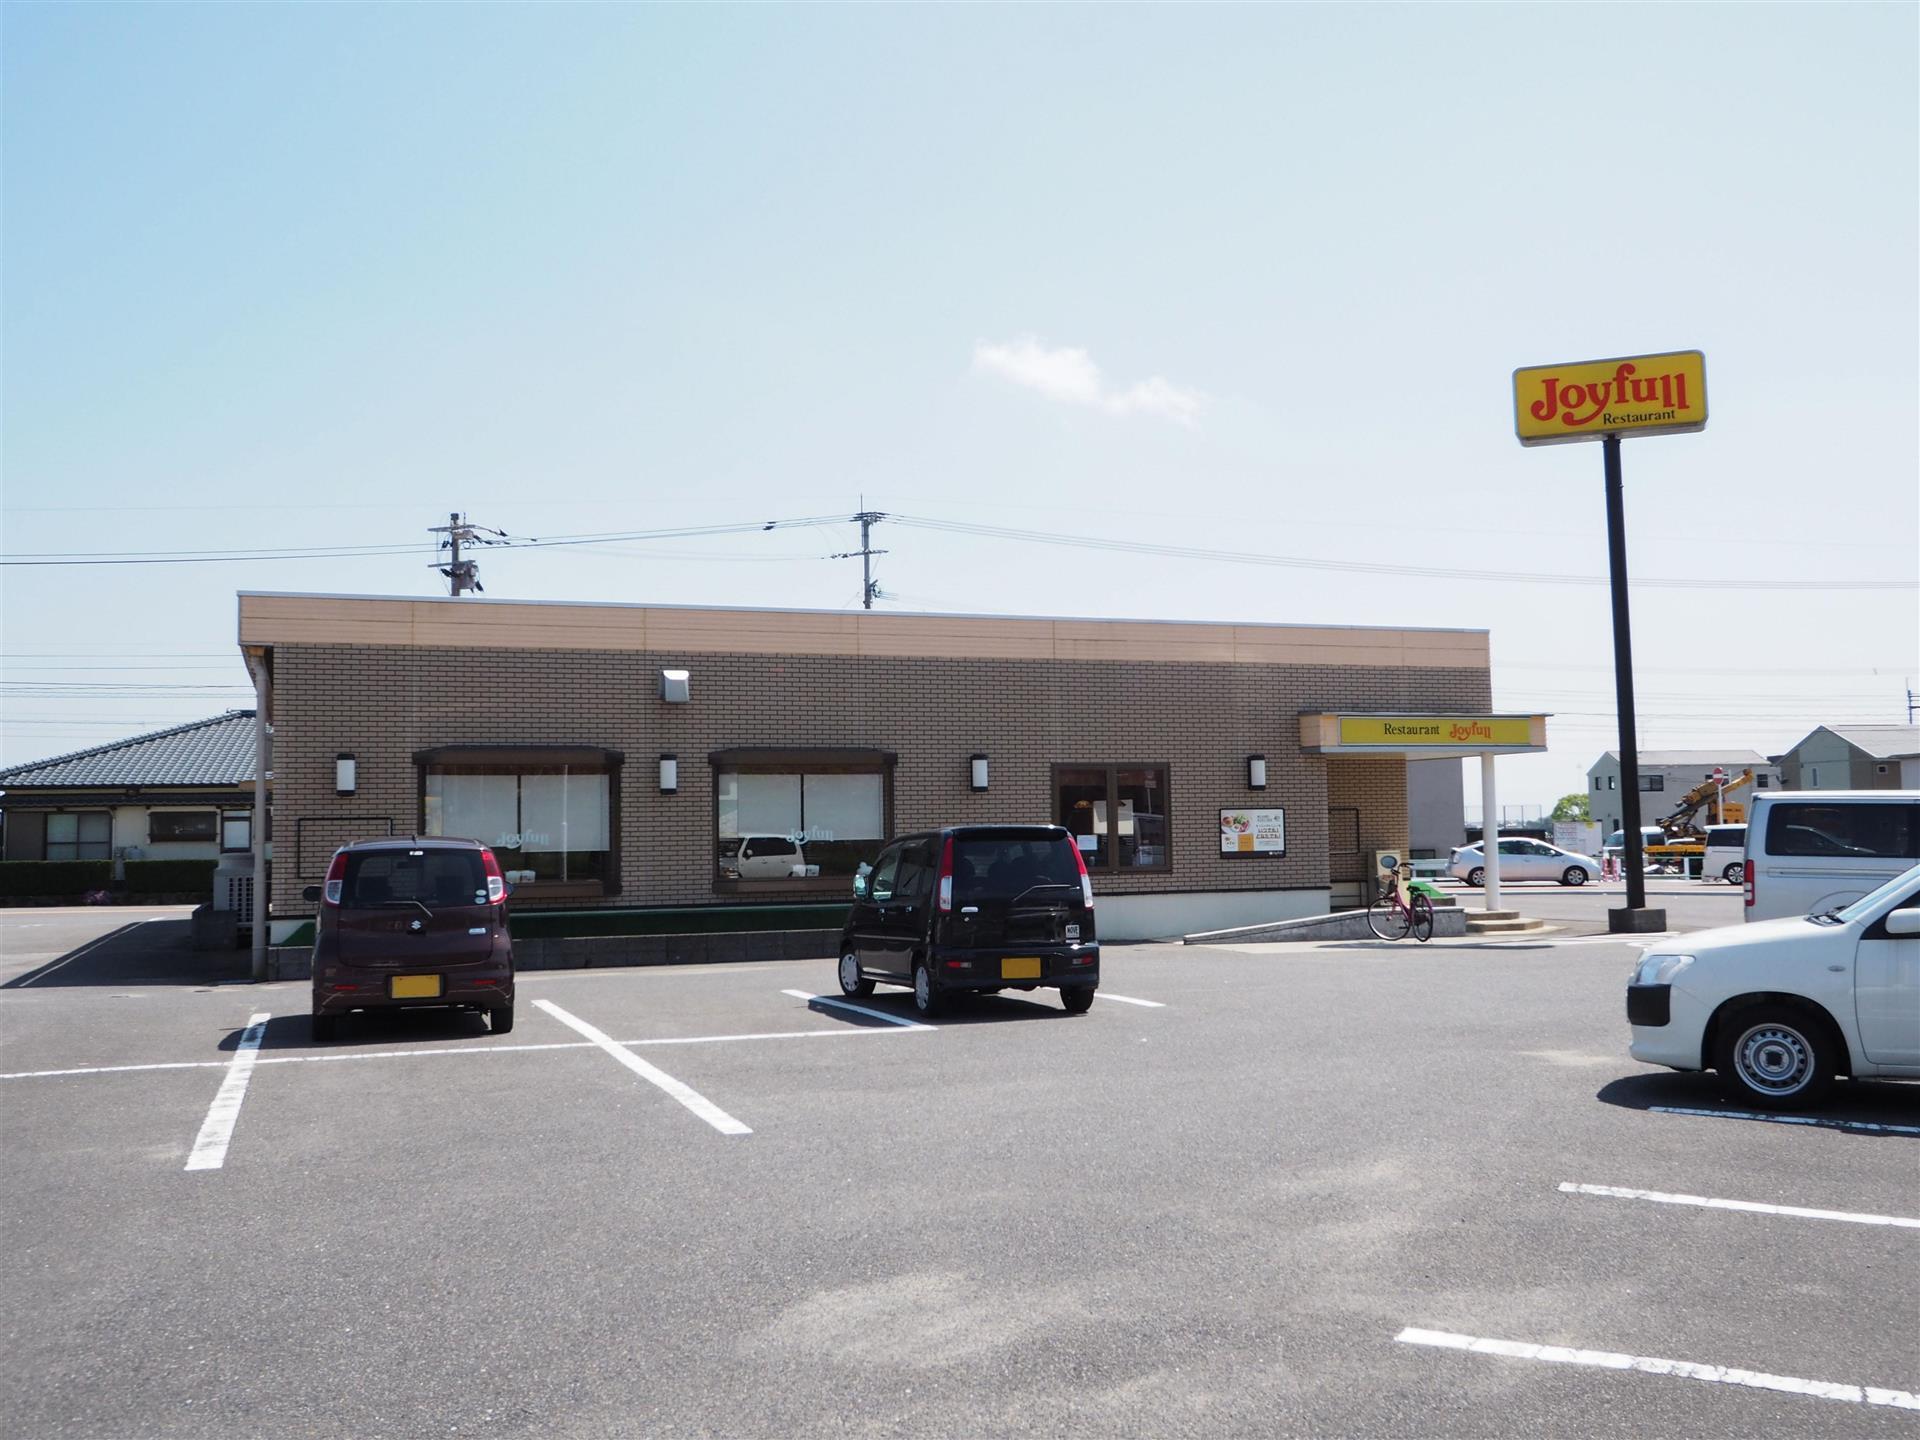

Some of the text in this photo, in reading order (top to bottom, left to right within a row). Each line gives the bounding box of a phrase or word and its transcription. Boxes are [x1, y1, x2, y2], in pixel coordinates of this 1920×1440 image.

[1530, 363, 1690, 426] Joyfull
[1603, 411, 1676, 425] Restaurant
[1384, 721, 1492, 741] Restaurant Joyfull
